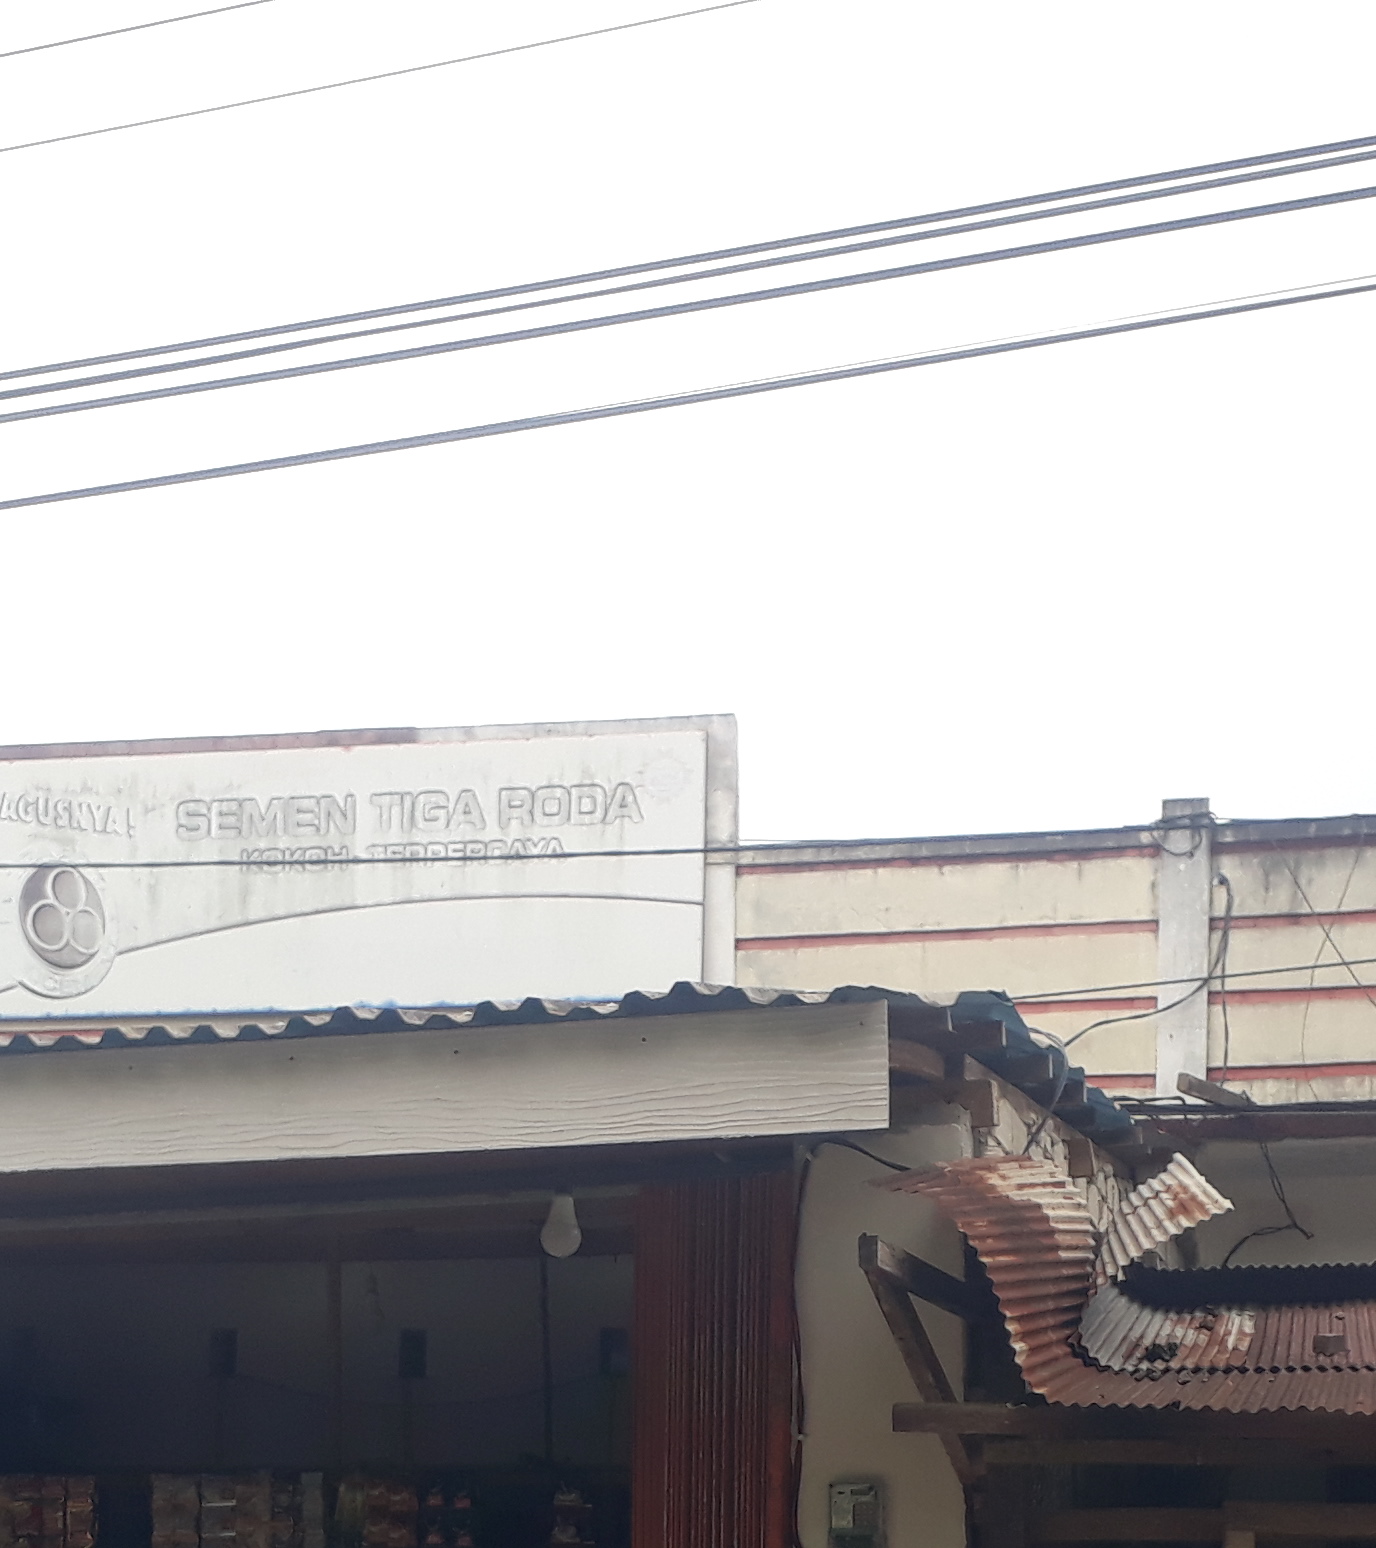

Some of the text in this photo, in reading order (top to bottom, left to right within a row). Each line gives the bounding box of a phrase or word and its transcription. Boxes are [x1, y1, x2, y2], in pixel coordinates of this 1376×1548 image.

[176, 782, 645, 841] SEMEN TIGA RODA
